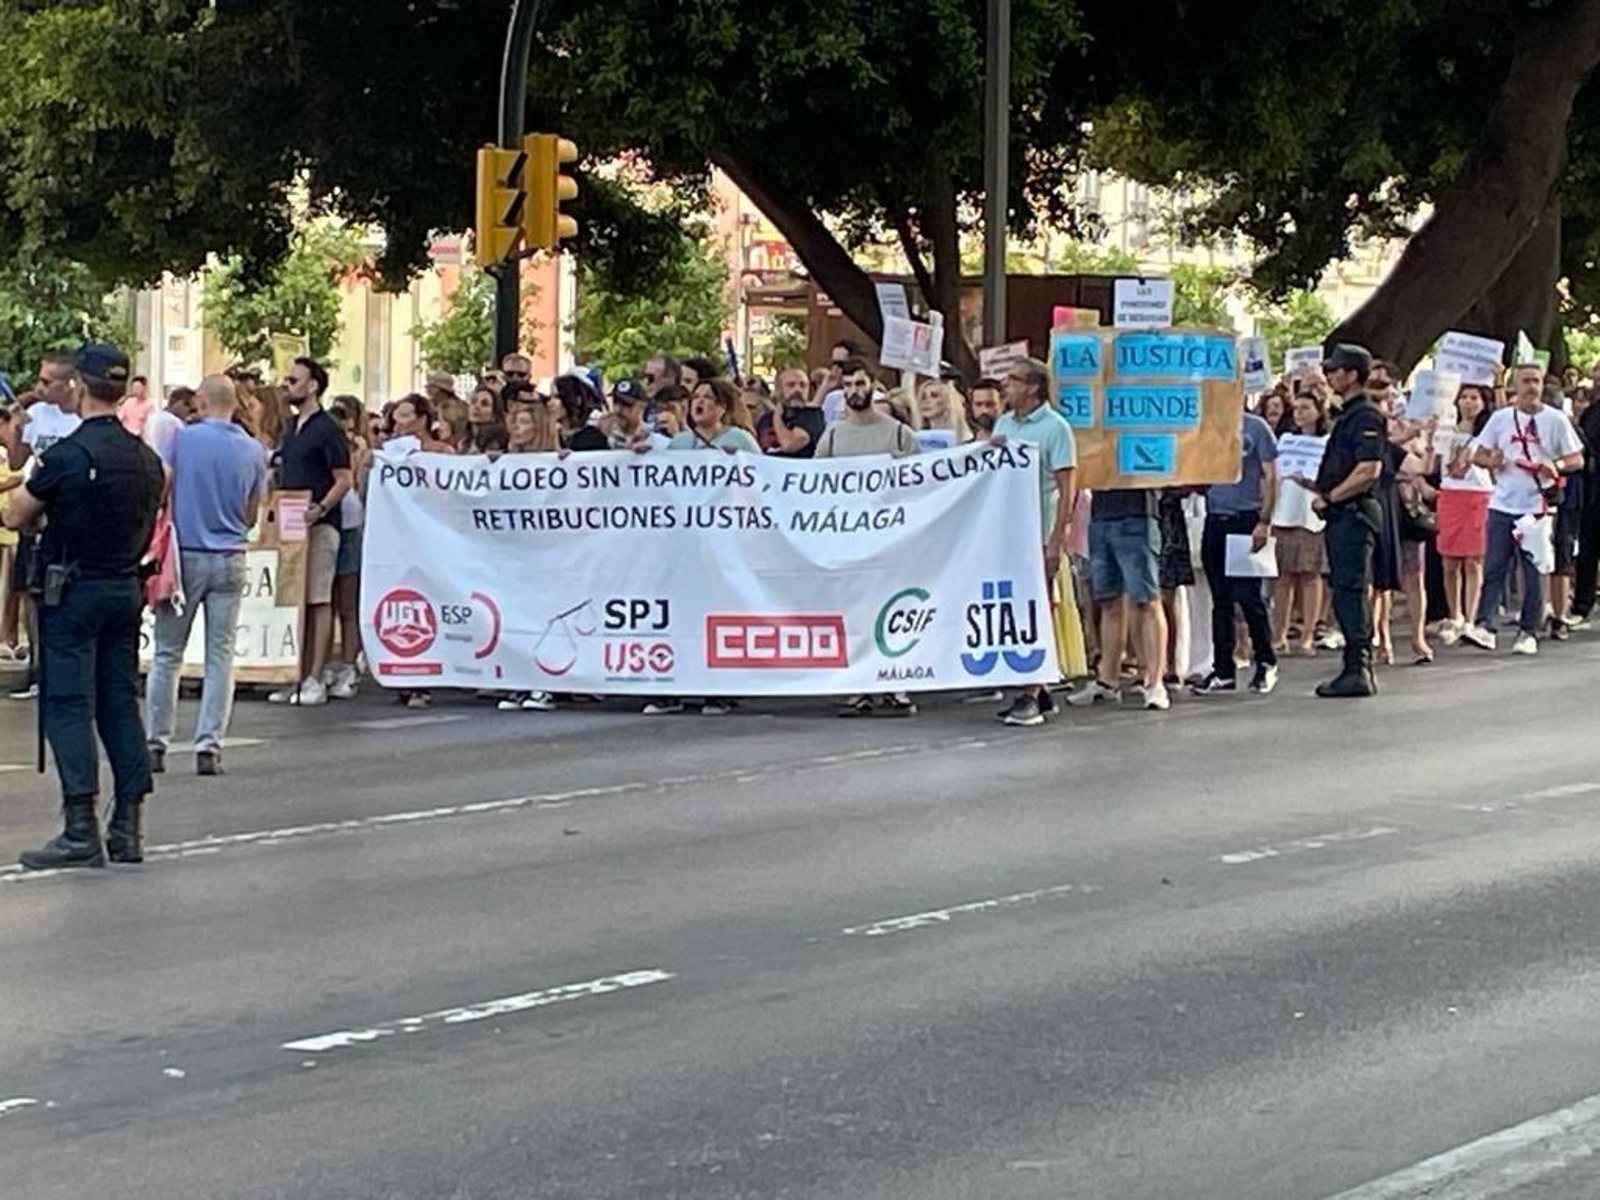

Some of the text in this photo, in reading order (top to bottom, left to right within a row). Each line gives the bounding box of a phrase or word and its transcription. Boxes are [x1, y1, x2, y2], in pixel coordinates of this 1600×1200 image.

[1059, 345, 1098, 369] LA
[1119, 345, 1232, 370] JUSTICIA
[1058, 397, 1200, 419] SE HUNDE
[380, 464, 429, 489] POR
[435, 468, 491, 491] UNA
[499, 466, 568, 491] LOEO
[577, 465, 620, 488] SIN
[781, 464, 924, 494] FUNCIONES
[932, 446, 1031, 482] CLARAS
[472, 507, 676, 531] RETRIBUCIONES
[790, 504, 906, 533] MÁLAGA
[604, 598, 670, 630] SPJ
[888, 608, 937, 635] CSIF
[965, 598, 1038, 649] STAJ
[714, 624, 837, 659] CCOO
[603, 642, 675, 673] USO
[876, 665, 935, 681] MÁLAGA
